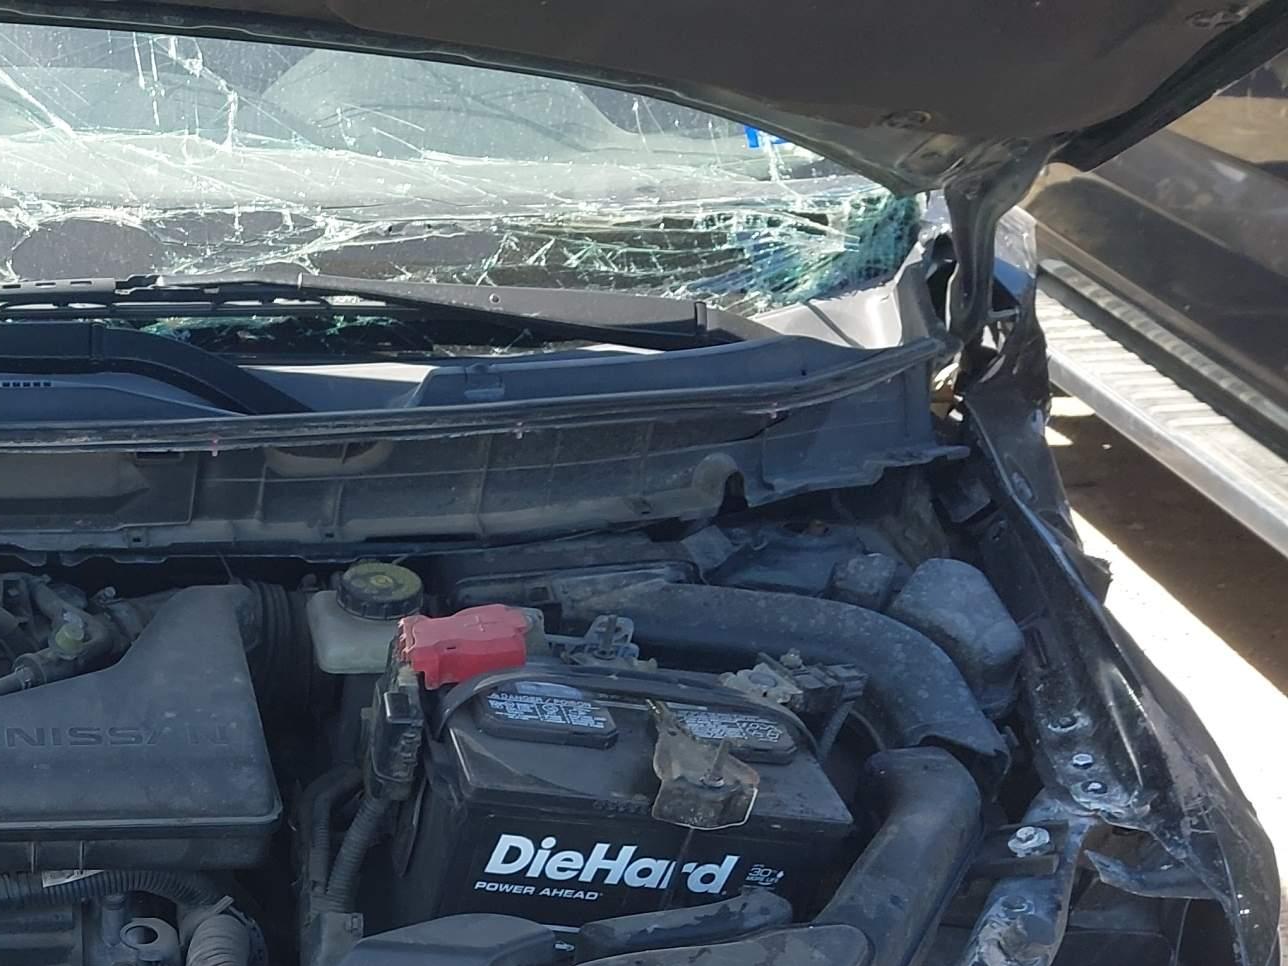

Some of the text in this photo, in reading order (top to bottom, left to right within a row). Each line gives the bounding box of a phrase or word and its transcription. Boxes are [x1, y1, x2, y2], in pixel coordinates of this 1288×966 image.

[484, 833, 739, 895] DieHard
[474, 880, 599, 901] POWER AHEAD
